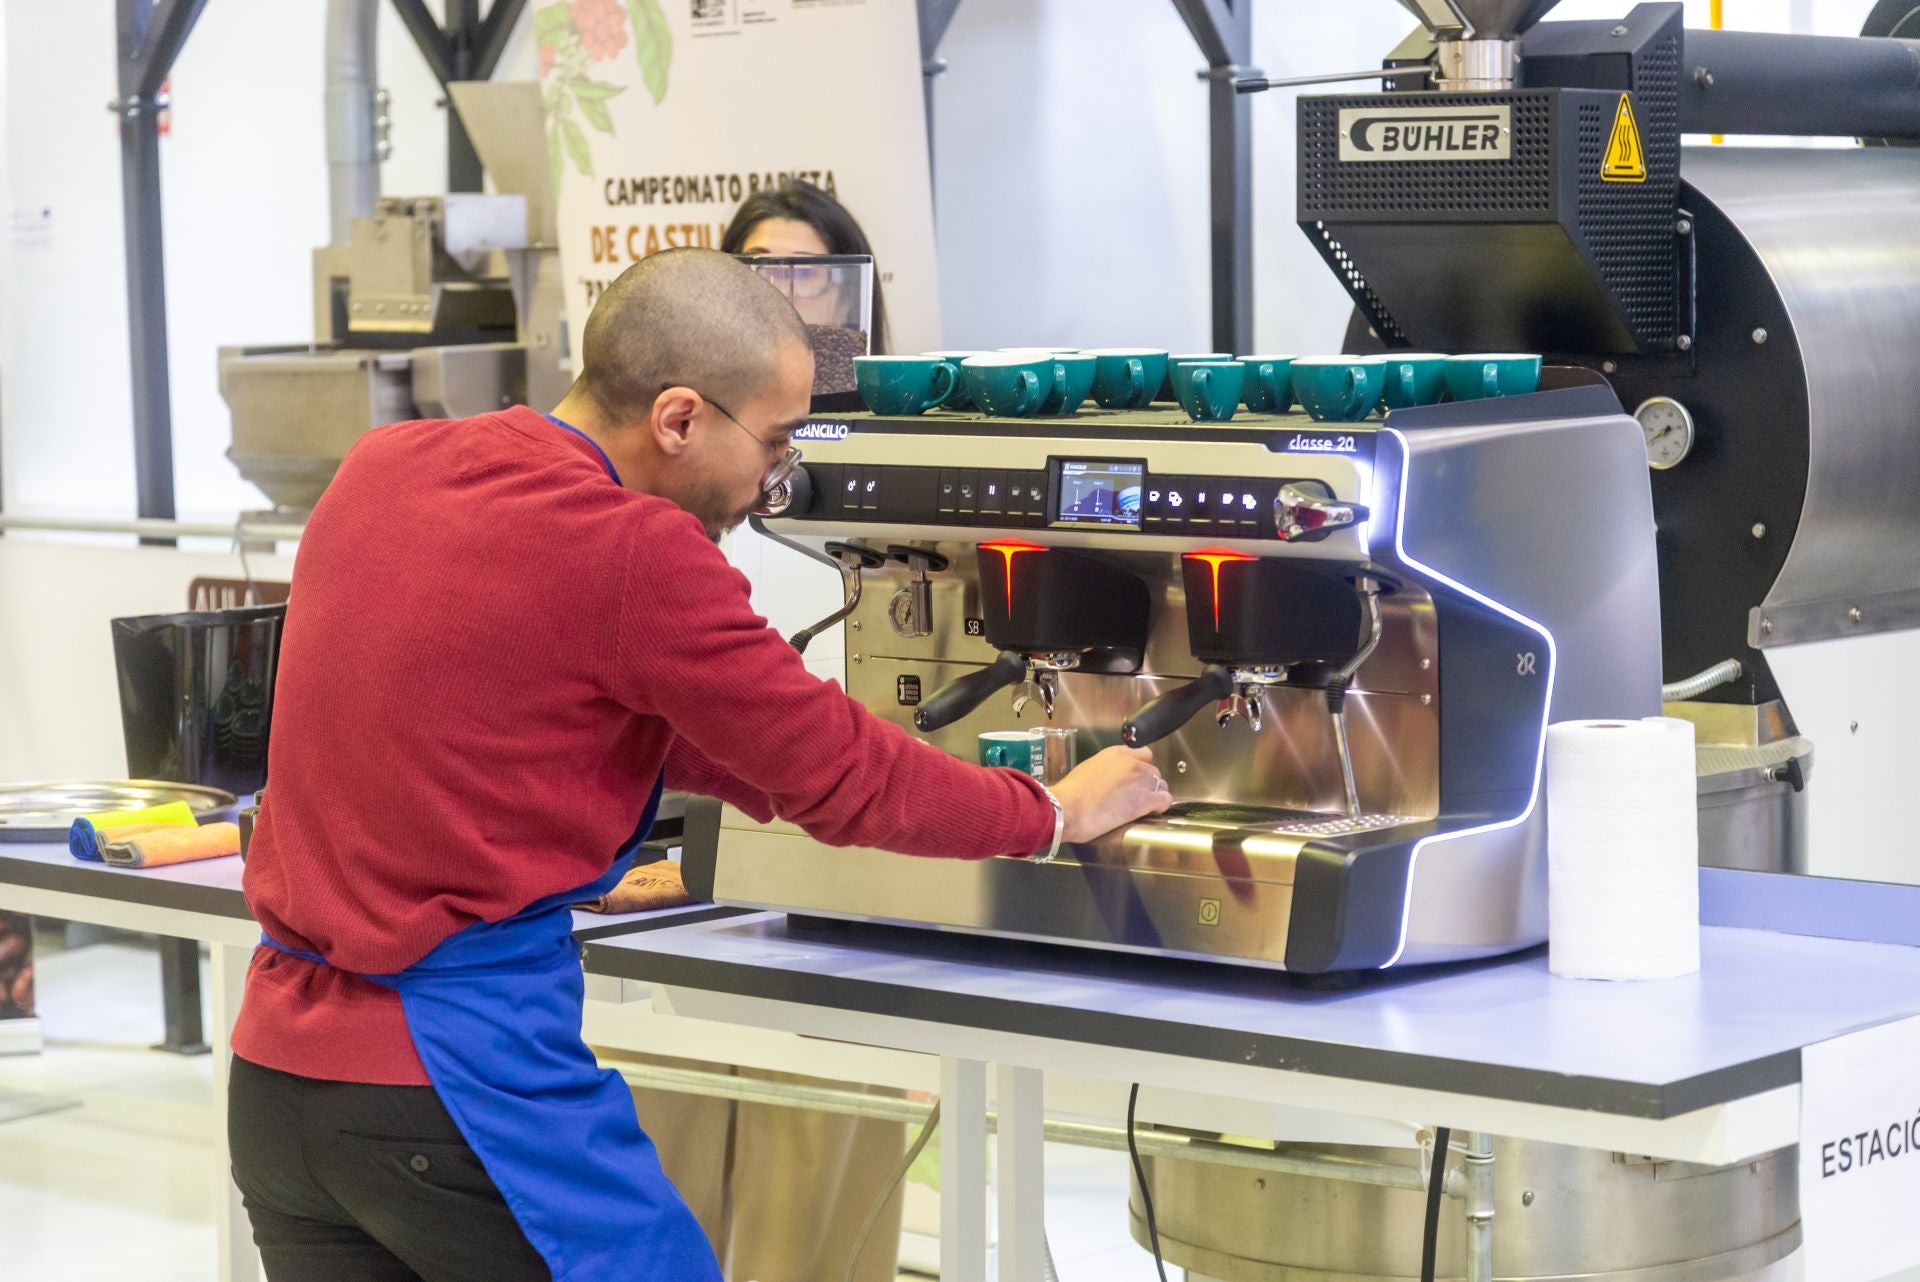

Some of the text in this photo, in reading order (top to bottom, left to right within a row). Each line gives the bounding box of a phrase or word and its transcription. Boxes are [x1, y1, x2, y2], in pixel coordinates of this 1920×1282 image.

[1382, 124, 1500, 152] BÜHLER
[604, 173, 742, 206] CAMPEONATO
[590, 225, 619, 264] DE
[1288, 434, 1356, 452] classe 20
